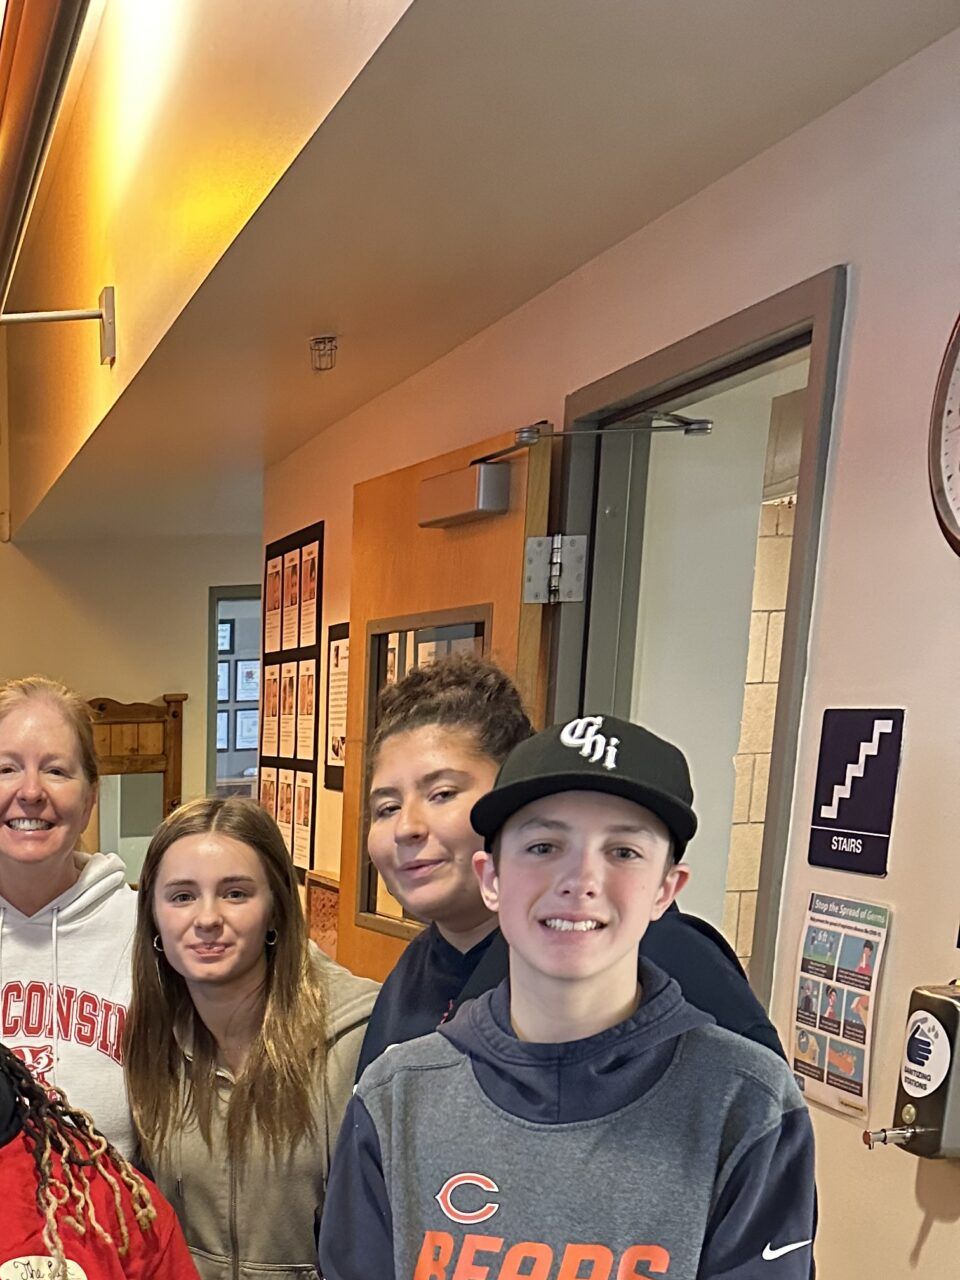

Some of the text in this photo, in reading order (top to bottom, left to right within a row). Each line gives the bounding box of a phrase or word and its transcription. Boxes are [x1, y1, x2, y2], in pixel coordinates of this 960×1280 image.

[559, 715, 621, 771] Chi
[831, 835, 863, 854] STAIRS
[814, 899, 885, 923] Stop the Spread of Germs
[904, 1065, 931, 1081] SANITIZING
[904, 1076, 928, 1091] STATIONS
[434, 1172, 500, 1225] C
[13, 1260, 45, 1280] The
